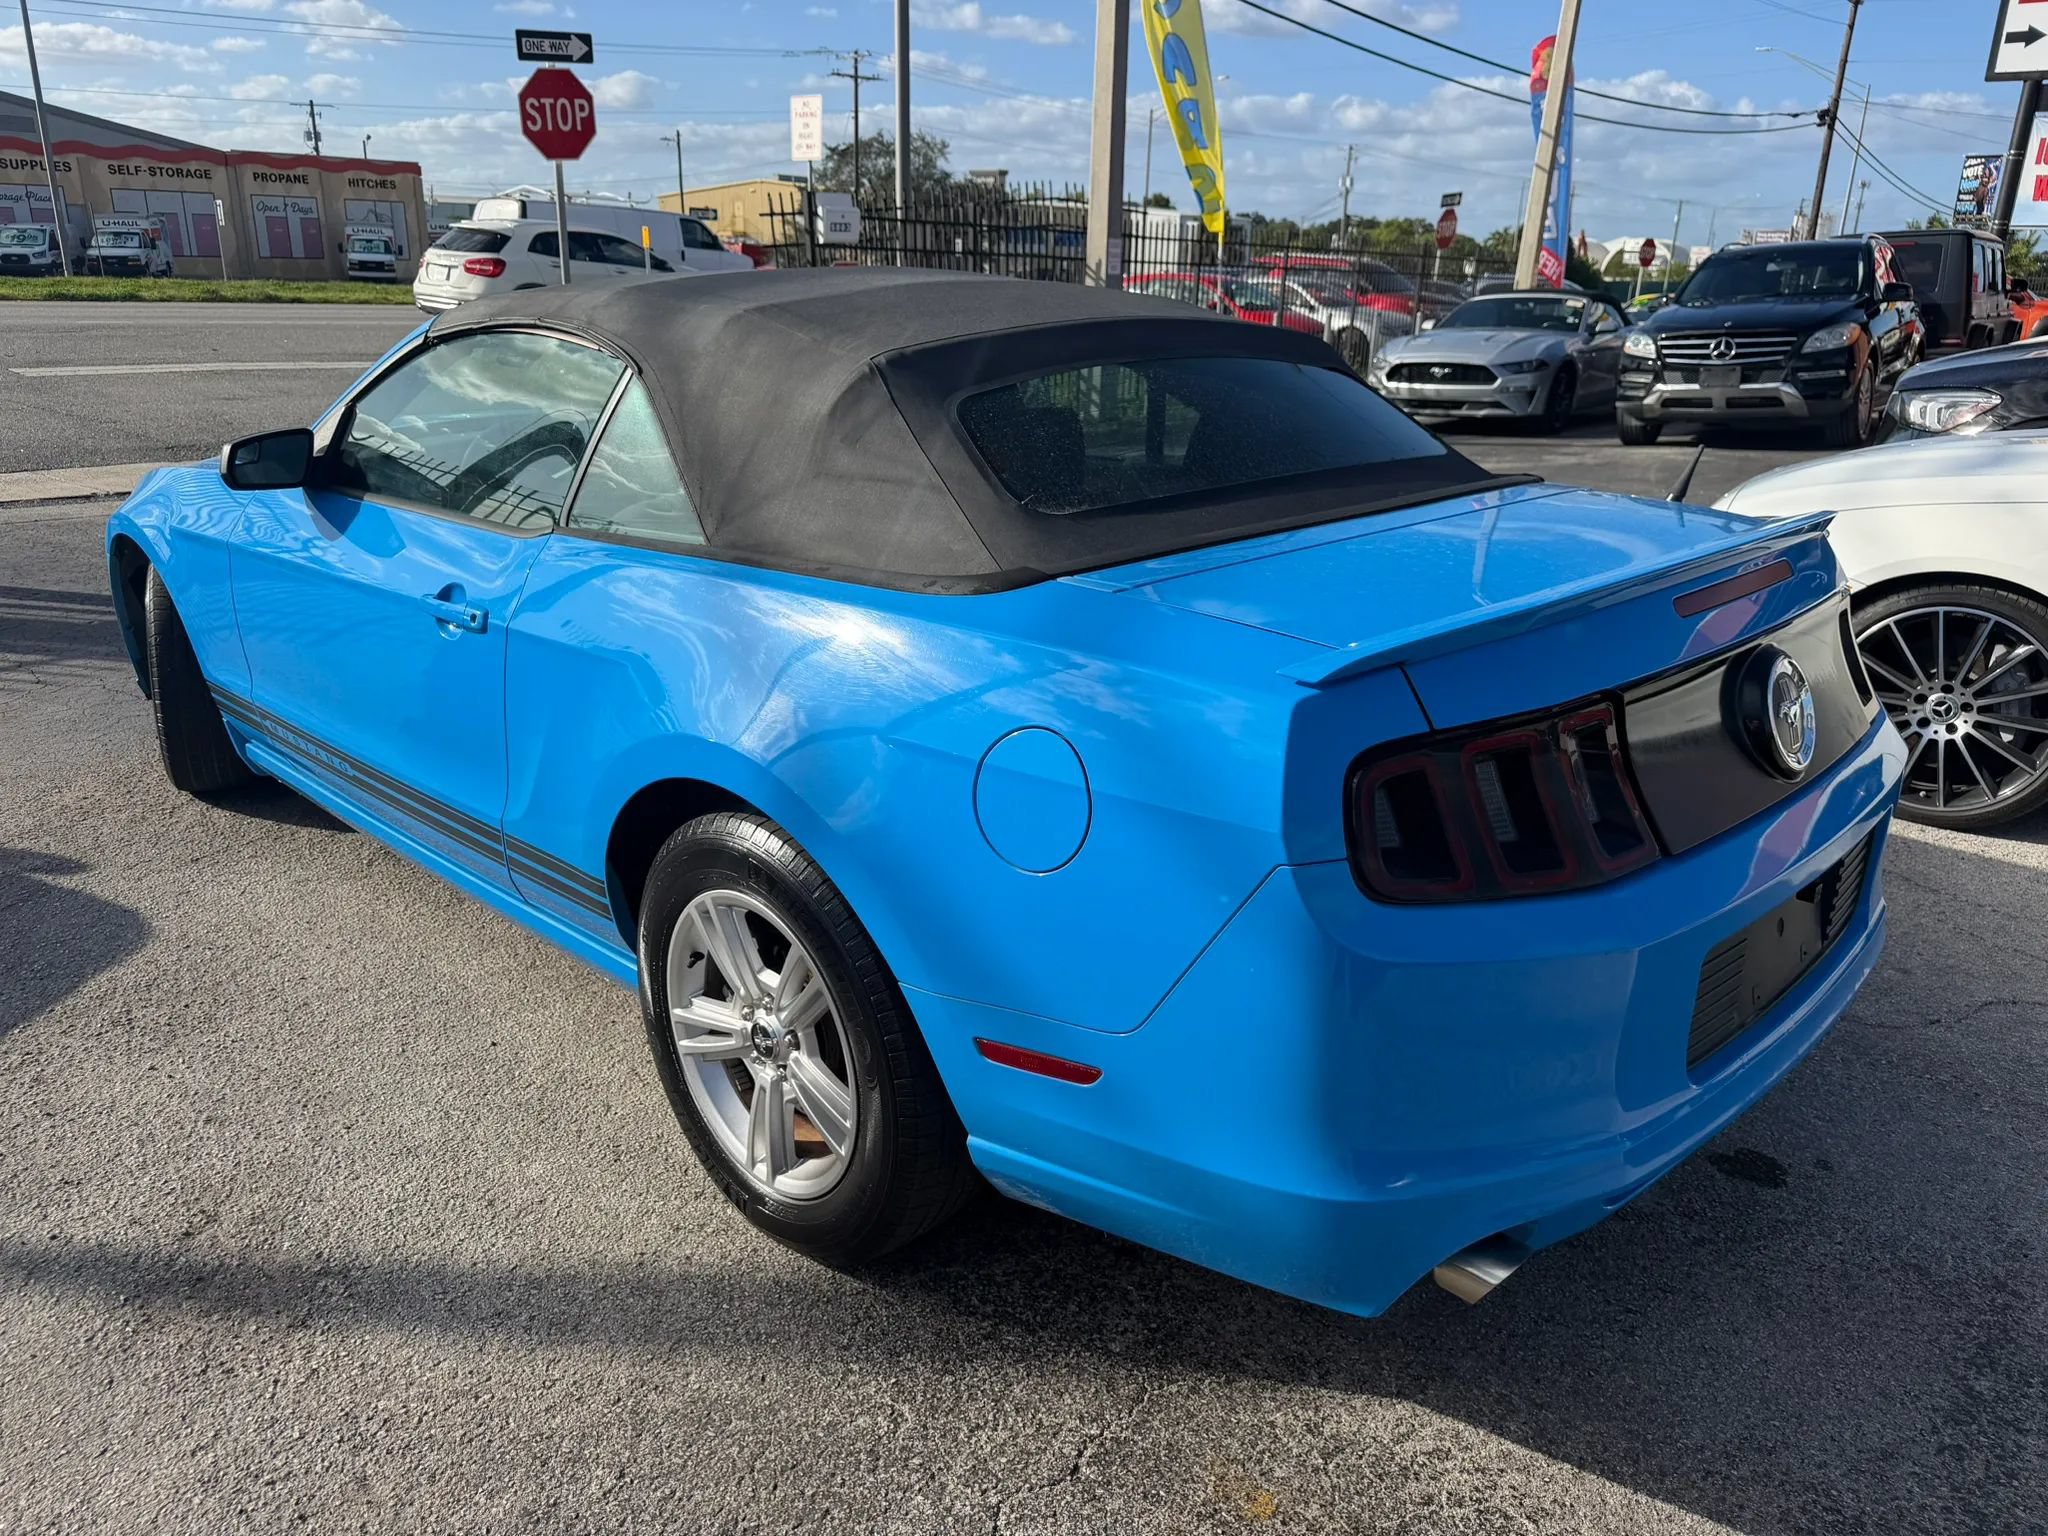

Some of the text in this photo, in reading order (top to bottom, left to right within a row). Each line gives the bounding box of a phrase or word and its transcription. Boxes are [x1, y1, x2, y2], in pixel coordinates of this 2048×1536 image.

[524, 39, 570, 53] ONE WAY
[525, 97, 590, 132] STOP
[0, 158, 72, 172] SUPPLES
[107, 164, 213, 179] SELF-STORAGE
[1963, 165, 1983, 178] VOTE
[252, 172, 309, 184] PROPANE
[348, 178, 397, 190] HITCHES
[256, 200, 281, 213] Open
[291, 202, 315, 215] Days
[352, 227, 386, 235] U-HAUL
[269, 723, 348, 772] MUSTANG
